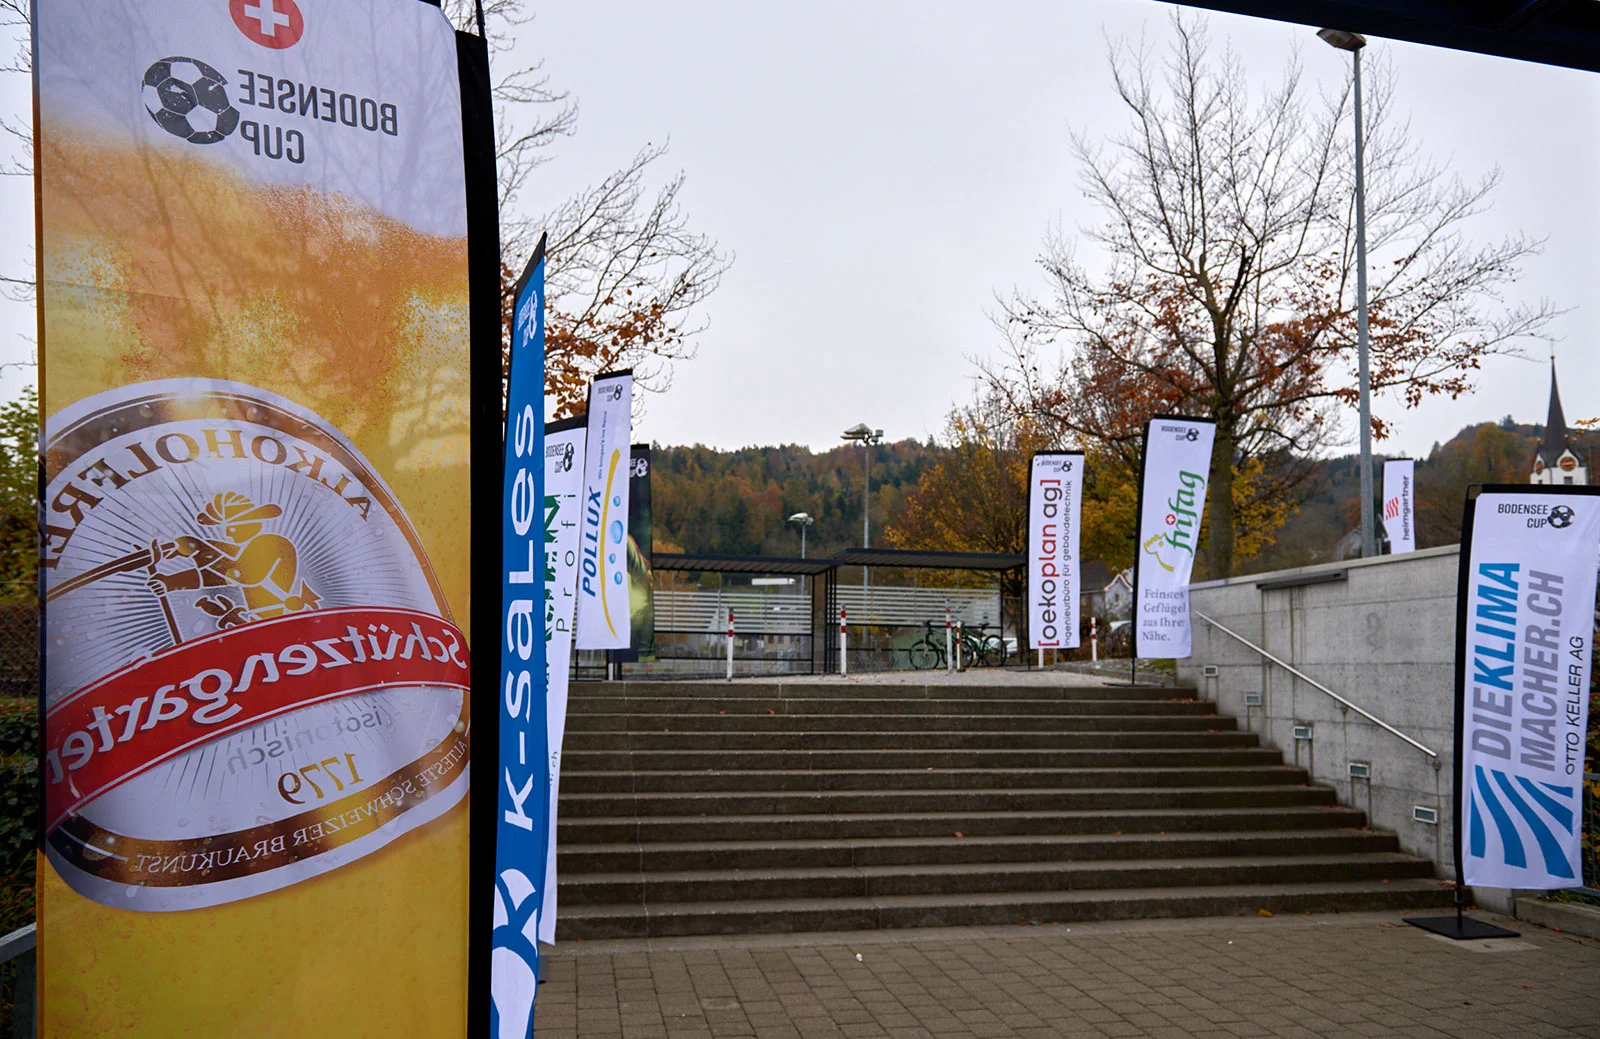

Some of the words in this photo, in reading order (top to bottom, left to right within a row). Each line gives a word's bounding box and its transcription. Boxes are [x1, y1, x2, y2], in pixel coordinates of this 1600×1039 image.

[1062, 480, 1073, 561] gebäudetechnik
[1165, 470, 1205, 557] frifag
[1401, 475, 1411, 541] heimgartner
[1497, 503, 1549, 515] BODENSEE
[1526, 517, 1548, 529] CUP
[582, 486, 601, 597] POLLUX
[1062, 563, 1071, 577] für
[1062, 579, 1072, 646] ingenieurbüro
[1143, 602, 1186, 615] Geflügel
[1471, 562, 1520, 760] DIEKLIMA
[1520, 569, 1564, 773] MACHER.CH
[1572, 636, 1584, 661] AG
[1566, 663, 1583, 722] KELLER
[1565, 730, 1580, 775] OTTO
